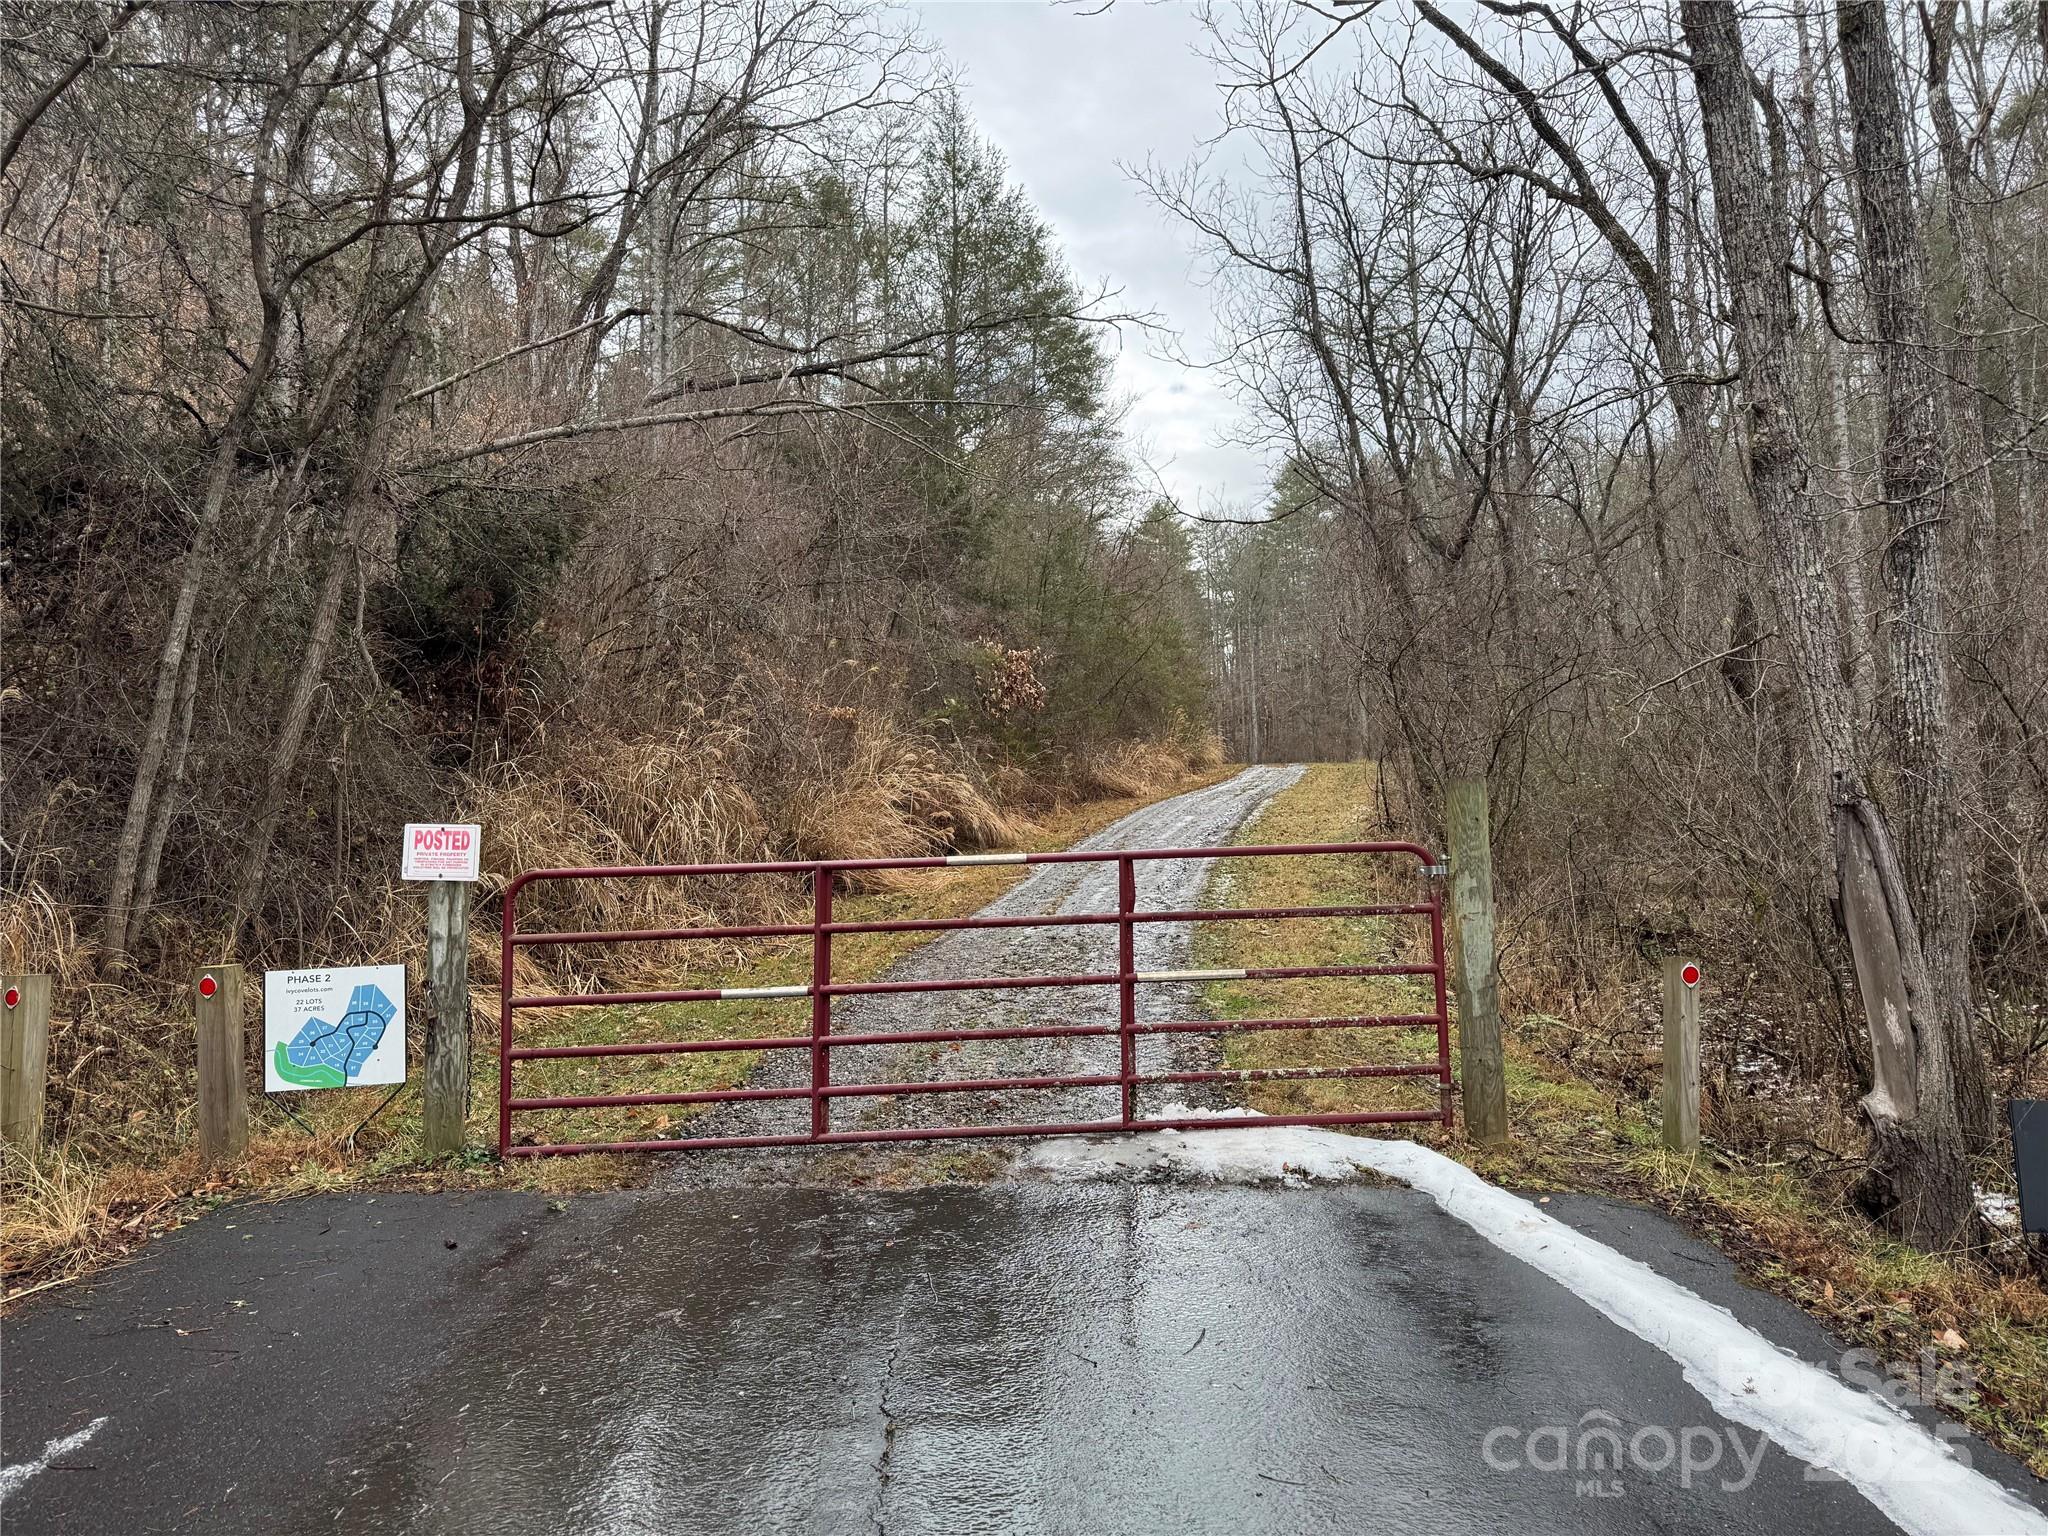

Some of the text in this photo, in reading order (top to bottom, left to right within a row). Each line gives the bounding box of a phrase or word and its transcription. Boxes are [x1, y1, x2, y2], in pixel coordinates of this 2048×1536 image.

[414, 830, 471, 851] POSTED
[287, 973, 331, 984] PHASE 2
